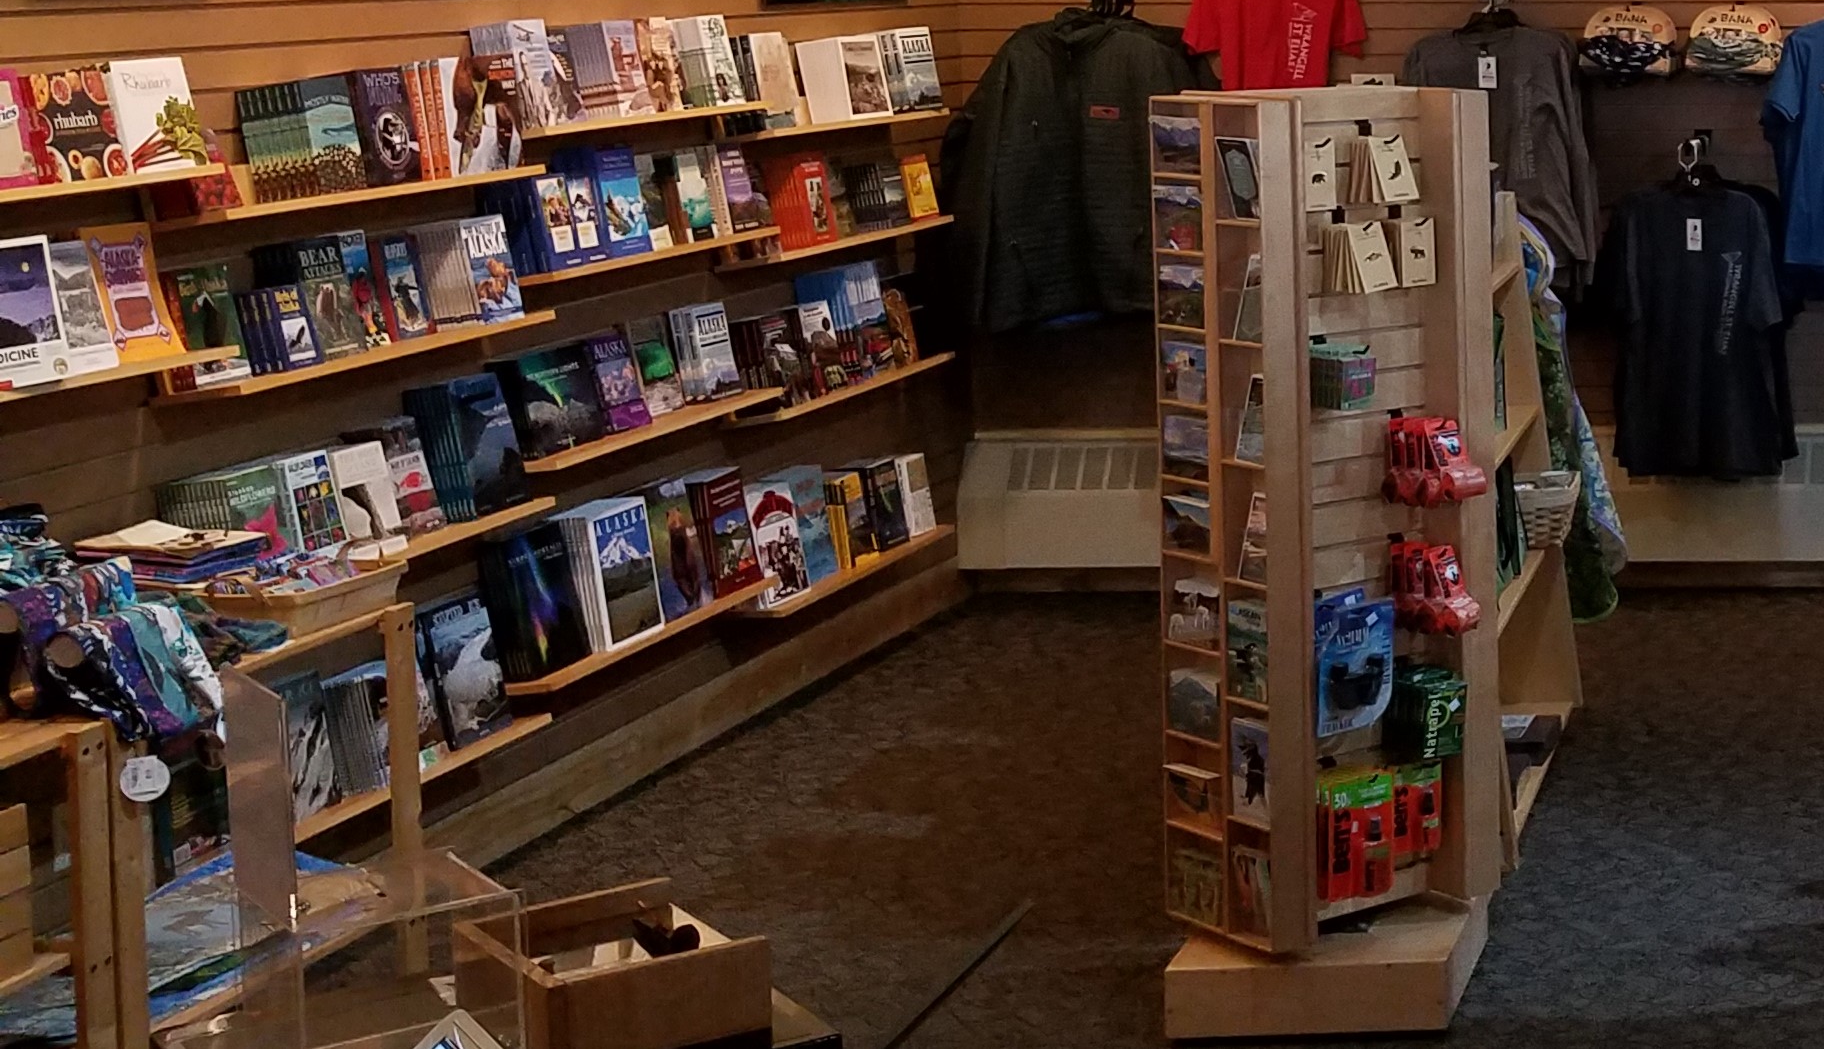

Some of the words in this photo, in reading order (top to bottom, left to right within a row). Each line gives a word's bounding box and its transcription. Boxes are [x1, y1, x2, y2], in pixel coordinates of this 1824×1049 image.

[901, 37, 932, 55] ALASKA
[120, 72, 171, 90] Rhubarb
[53, 110, 99, 130] rhubarb
[300, 247, 340, 268] BEAR
[697, 314, 727, 338] ALASKA
[594, 339, 627, 360] ALASKA
[594, 505, 645, 537] ALASKA
[1423, 691, 1441, 759] Natrapel
